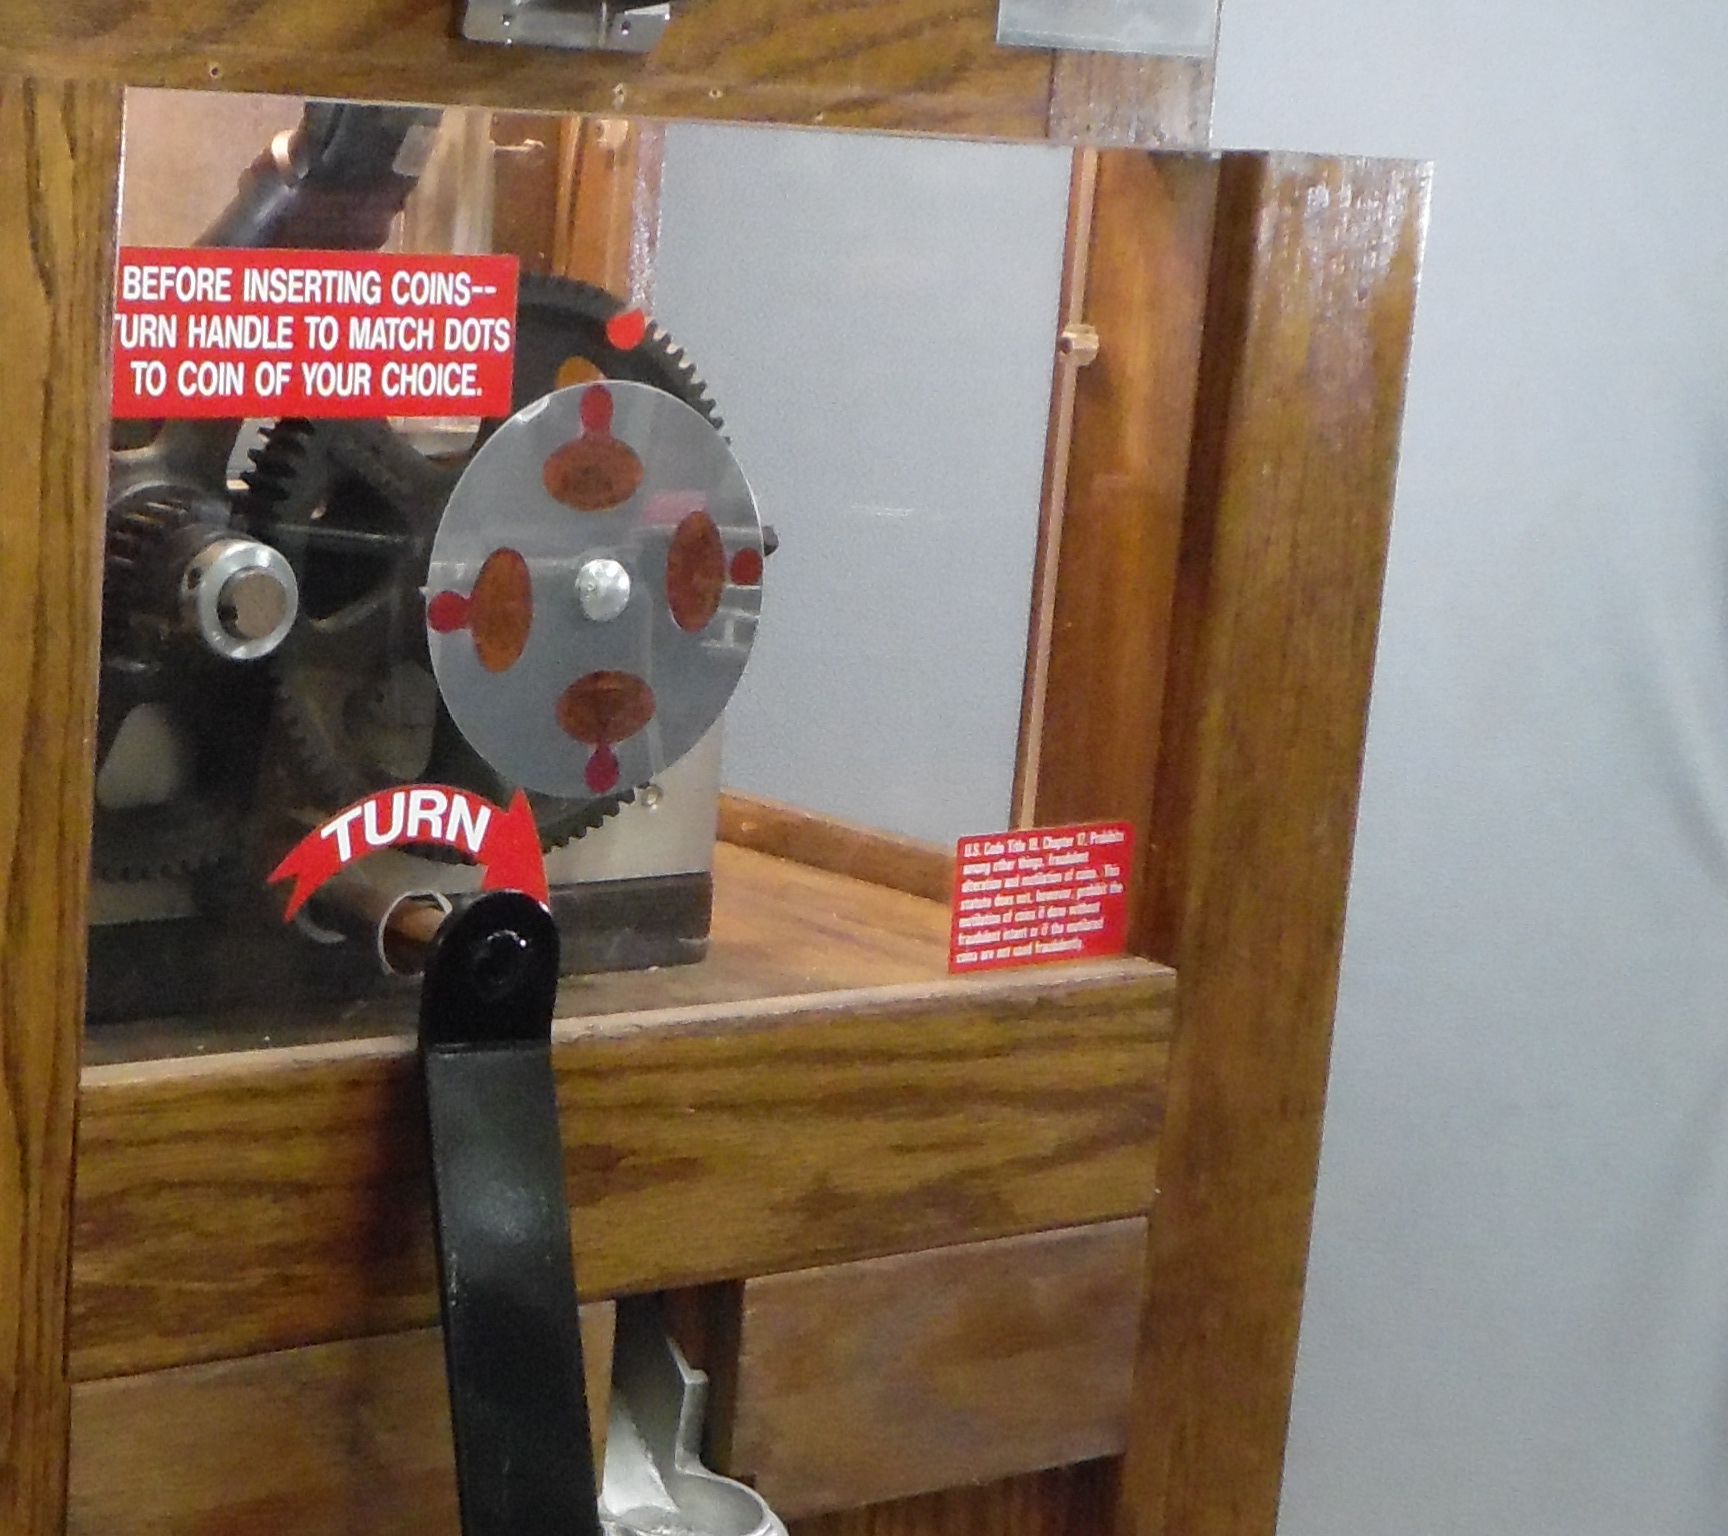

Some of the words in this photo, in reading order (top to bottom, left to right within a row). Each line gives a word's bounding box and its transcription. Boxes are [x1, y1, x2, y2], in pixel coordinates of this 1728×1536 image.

[122, 265, 232, 302] BEFORE
[243, 269, 381, 304] INSERTING
[390, 271, 497, 307] COINS--
[188, 315, 294, 350] HANDLE
[304, 316, 338, 350] TO
[348, 317, 434, 351] MATCH
[443, 319, 511, 353] DOTS
[130, 361, 166, 395] TO
[177, 361, 244, 395] COIN
[254, 362, 292, 395] OF
[302, 362, 371, 396] YOUR
[381, 363, 482, 396] CHOICE.
[320, 788, 493, 862] TURN
